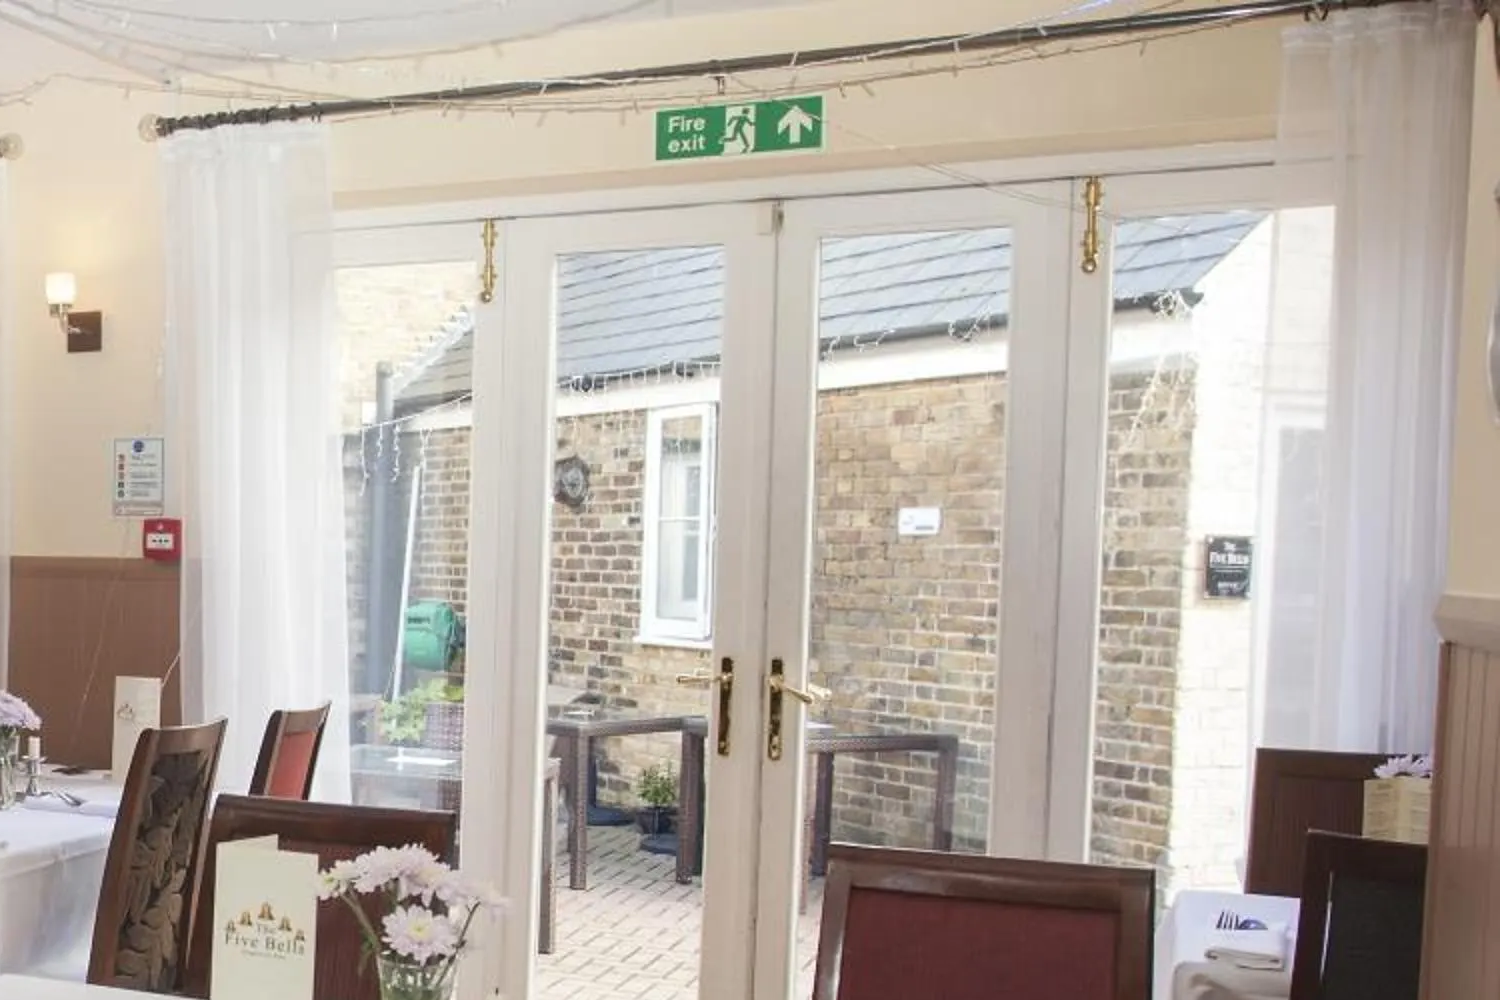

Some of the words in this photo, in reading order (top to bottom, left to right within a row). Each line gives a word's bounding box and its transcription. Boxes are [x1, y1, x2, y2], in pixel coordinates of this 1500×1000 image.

[668, 115, 706, 133] Fire
[668, 134, 706, 153] exit
[225, 931, 259, 948] Five
[265, 935, 305, 955] Bells
